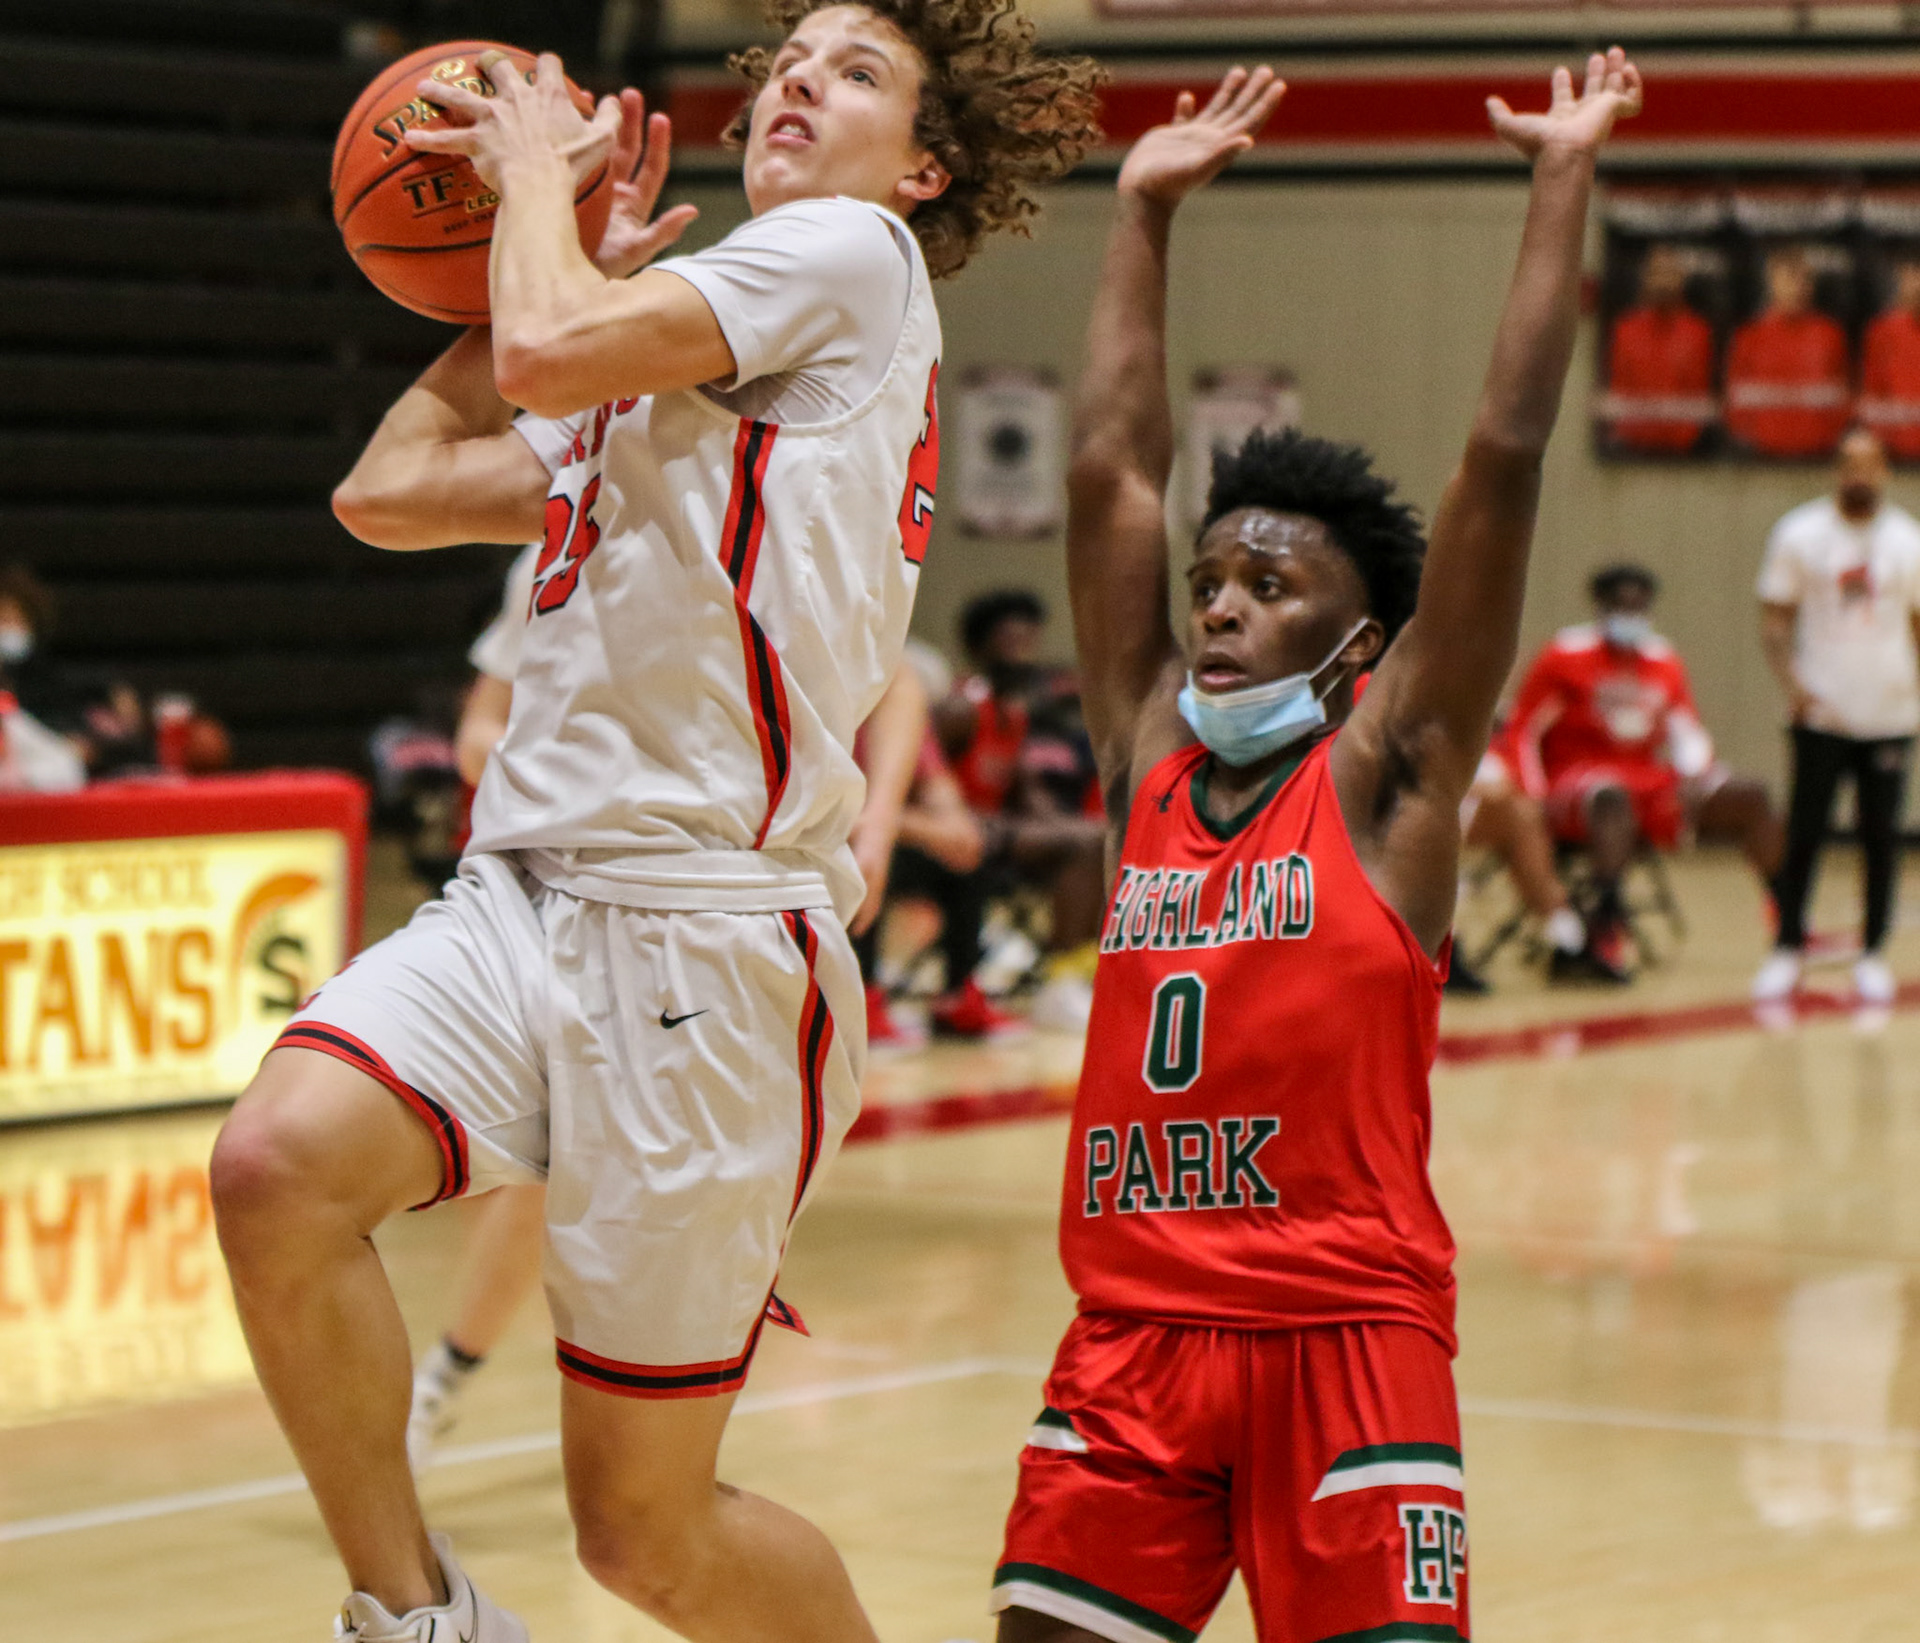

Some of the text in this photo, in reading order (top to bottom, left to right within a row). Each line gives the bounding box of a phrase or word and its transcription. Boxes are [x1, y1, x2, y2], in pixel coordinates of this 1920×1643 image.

[1101, 852, 1315, 954] HIGHLAND
[1142, 970, 1207, 1093] 0
[1083, 1117, 1279, 1217] PARK
